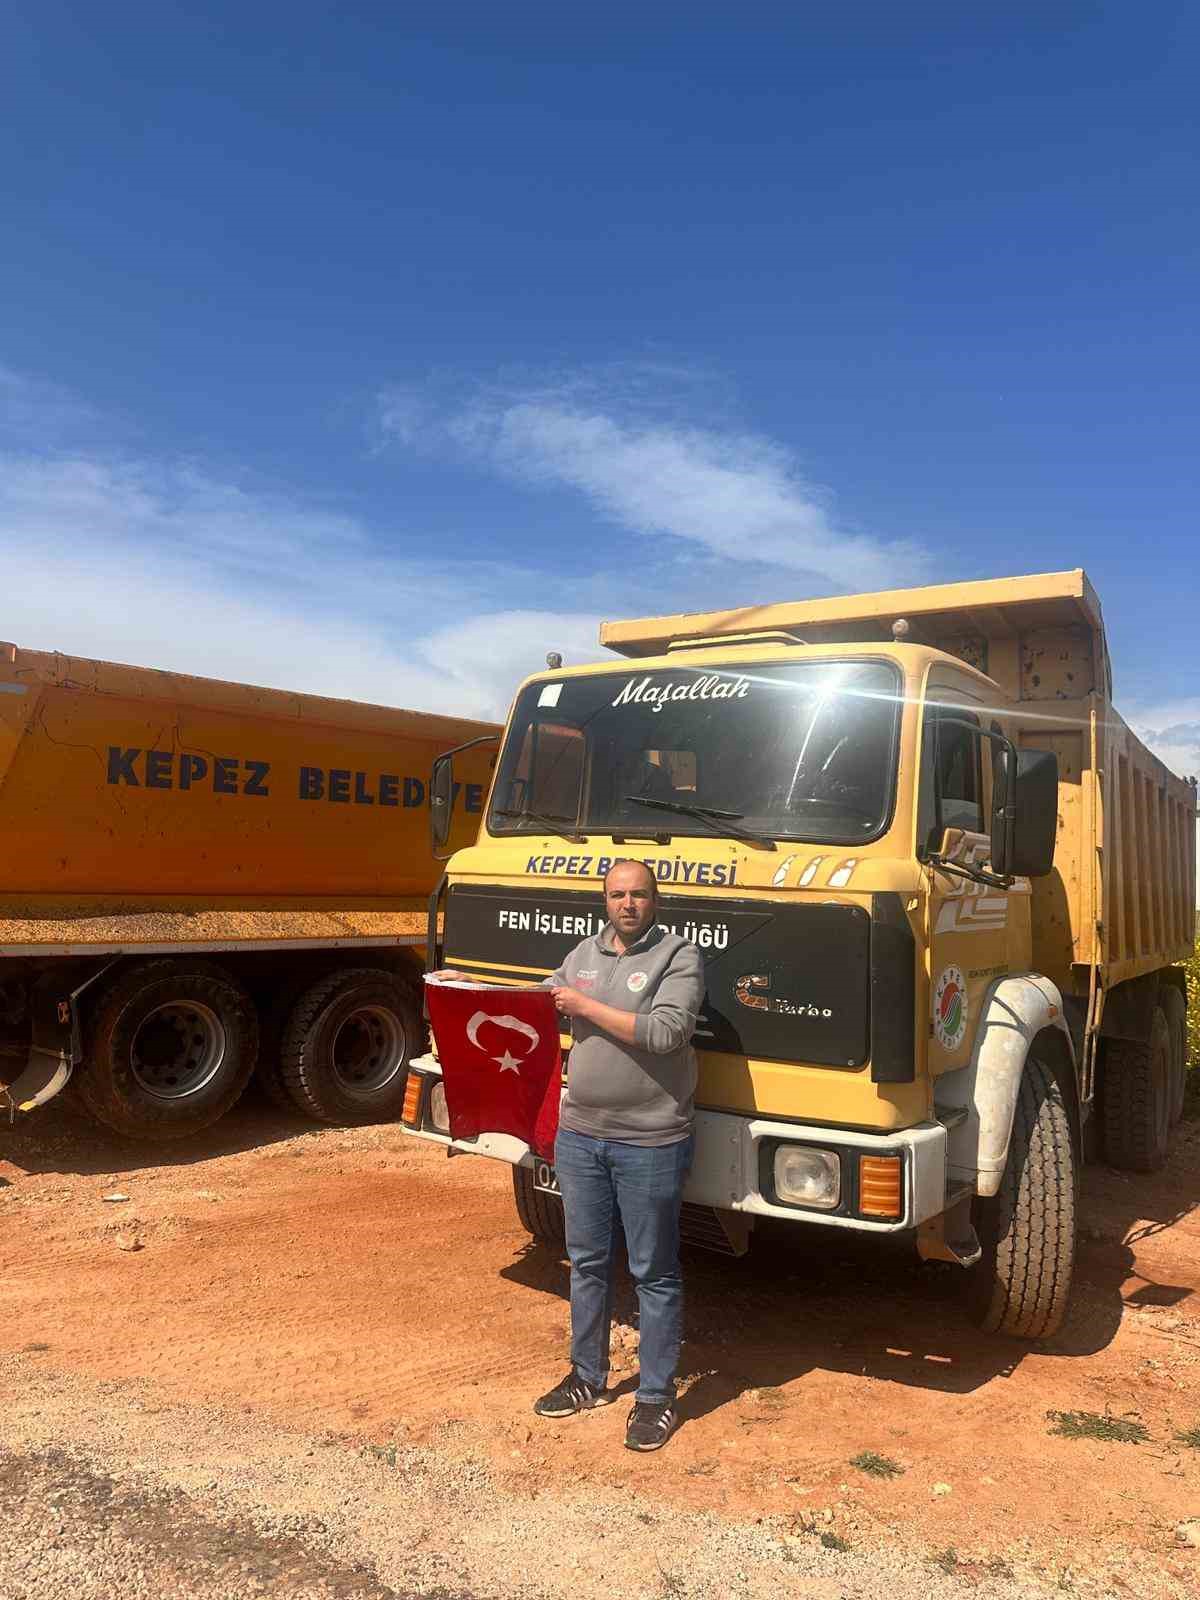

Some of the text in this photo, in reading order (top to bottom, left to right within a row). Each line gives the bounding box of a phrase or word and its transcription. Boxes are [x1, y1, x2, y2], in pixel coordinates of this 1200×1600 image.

[611, 674, 751, 712] Maşallah
[106, 746, 271, 796] KEPEZ
[526, 855, 737, 886] KEPEZ BDİYESİ
[498, 910, 530, 930] FEN
[535, 908, 592, 936] İŞLERİ
